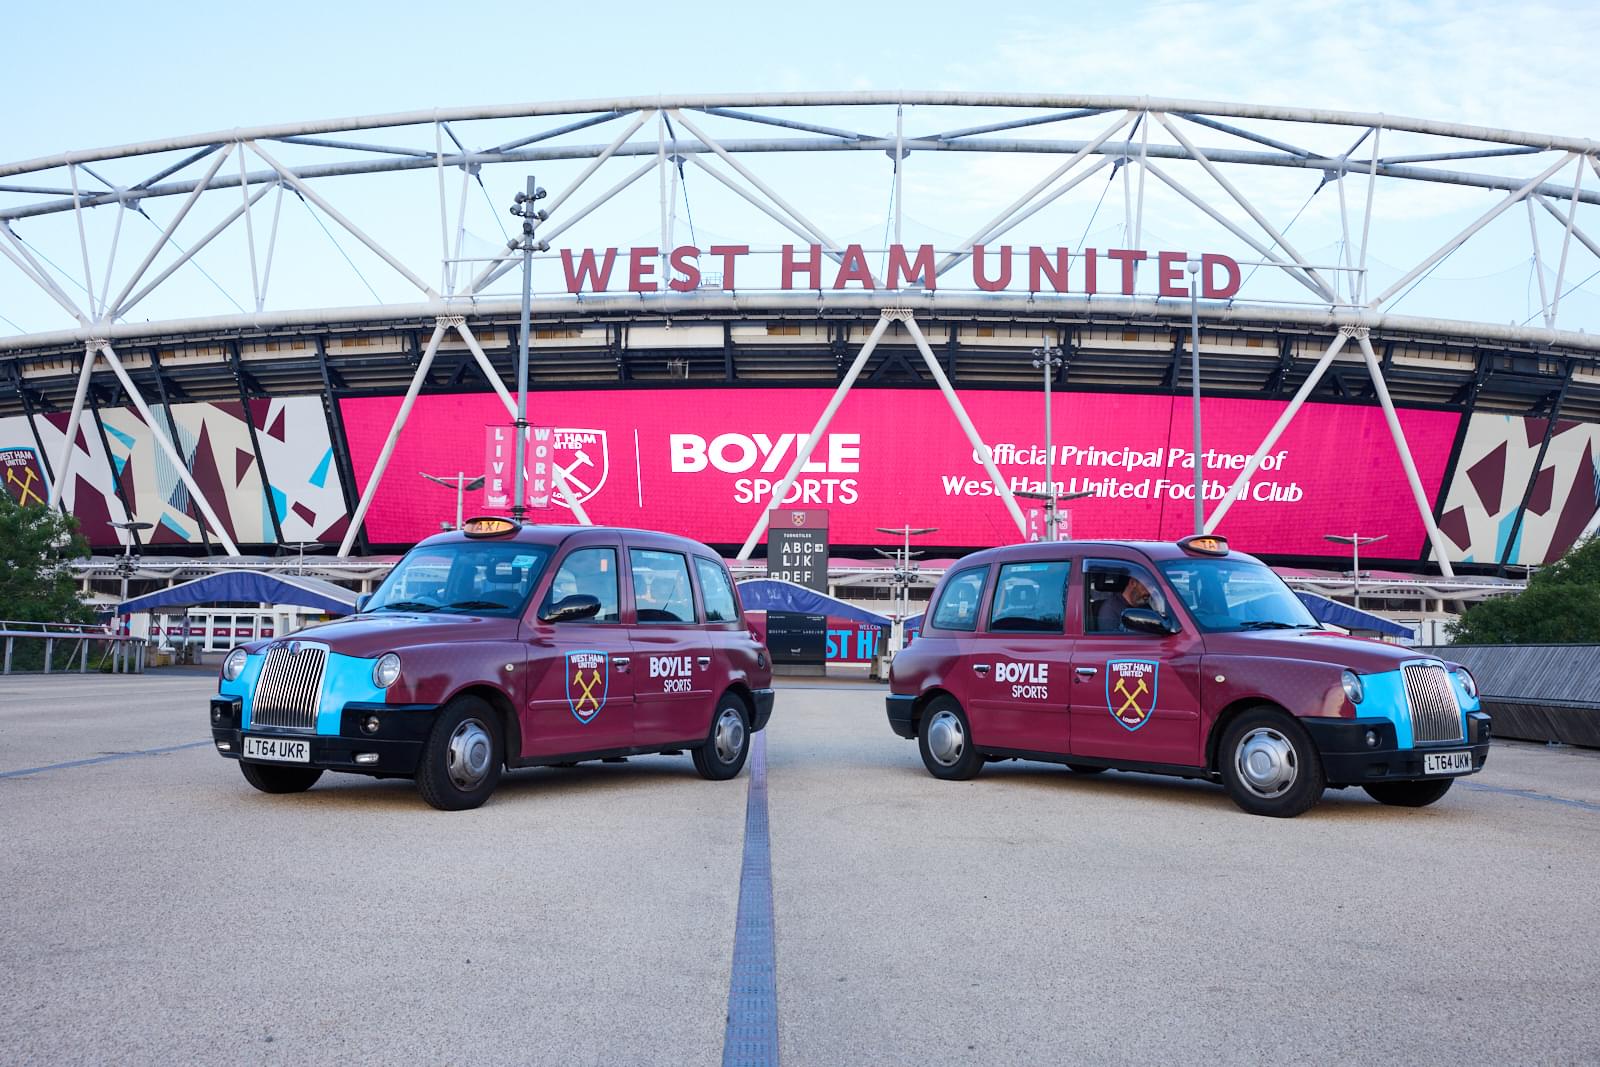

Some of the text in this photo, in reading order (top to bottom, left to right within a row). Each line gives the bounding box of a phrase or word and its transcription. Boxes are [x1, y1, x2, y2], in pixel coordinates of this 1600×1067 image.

[560, 244, 1241, 299] WEST HAM UNITED
[564, 433, 597, 444] HAM
[492, 428, 504, 491] LIVE
[534, 428, 550, 491] WORK
[669, 433, 861, 474] BOYLE
[972, 443, 1057, 465] Official
[1060, 445, 1163, 472] Principal
[1259, 450, 1288, 471] of
[734, 478, 859, 505] SPORTS
[1068, 477, 1150, 499] United
[1153, 479, 1251, 500] Footbll
[1252, 481, 1303, 502] Club
[826, 629, 852, 659] ST
[570, 654, 604, 664] WEST HAM
[650, 656, 692, 678] BOYLE
[1112, 663, 1152, 673] WEST HAM
[995, 663, 1049, 684] BOYLE
[1119, 670, 1144, 678] UNITED
[663, 679, 692, 693] SPORTS
[1012, 685, 1048, 700] SPORTS
[248, 739, 304, 759] LT64 UKR
[1428, 755, 1452, 770] LT64
